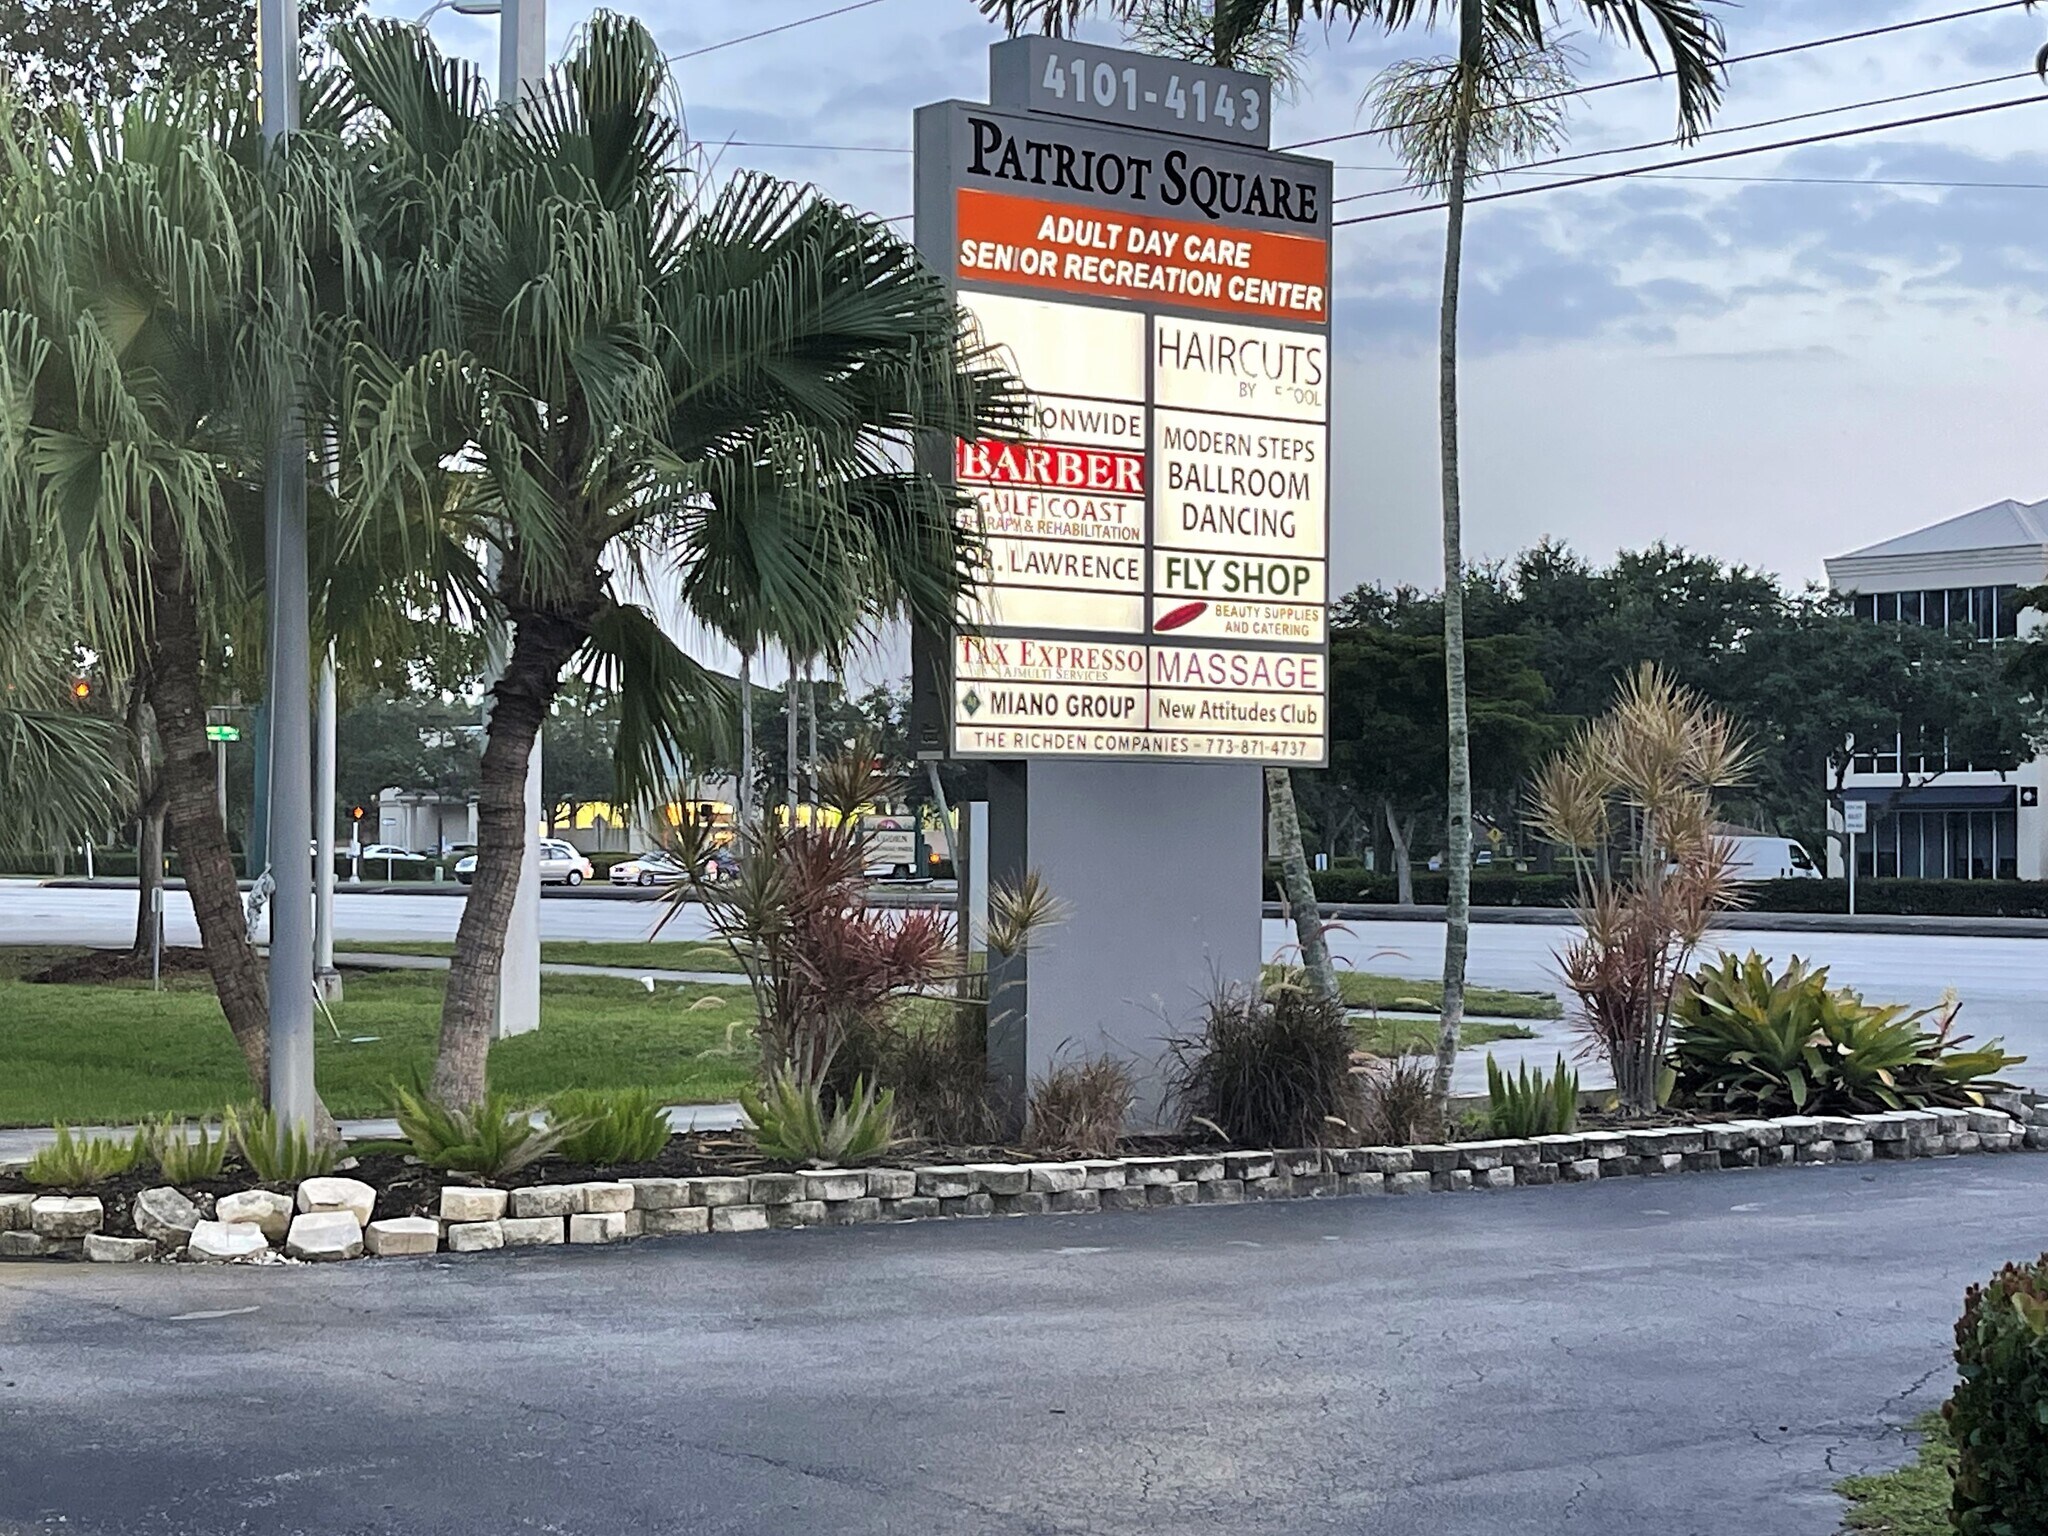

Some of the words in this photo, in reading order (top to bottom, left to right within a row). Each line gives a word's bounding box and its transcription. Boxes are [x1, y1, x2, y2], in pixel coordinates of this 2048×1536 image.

[1042, 54, 1262, 132] 4101-4143
[967, 117, 1152, 200] PATRIOT
[1160, 149, 1319, 224] SQUARE
[1037, 214, 1124, 251] ADULT
[1126, 226, 1179, 257] DAY
[1183, 235, 1252, 268] CARE
[960, 240, 1057, 277] SENIOR
[1064, 254, 1221, 299] RECREATION
[1227, 275, 1323, 311] CENTER
[1158, 326, 1322, 386] HAIRCUTS
[1239, 381, 1257, 398] BY
[1163, 426, 1252, 457] MODERN
[1257, 435, 1315, 463] STEPS
[961, 443, 1144, 492] BARBER
[1168, 461, 1310, 501] BALLROOM
[1047, 497, 1127, 524] COAST
[1182, 502, 1296, 538] DANCING
[1024, 519, 1034, 533] &
[1037, 520, 1141, 541] REHABILITATION
[1010, 549, 1140, 581] LAWRENCE
[1166, 556, 1216, 591] FLY
[1222, 560, 1310, 596] SHOP
[1215, 604, 1261, 619] BEAUTY
[1264, 607, 1319, 622] SUPPLIES
[1225, 621, 1249, 634] AND
[1252, 622, 1309, 636] CATERING
[1020, 640, 1144, 673] EXPRESSO
[1156, 650, 1318, 689] MASSAGE
[1056, 668, 1108, 681] SERVICES
[991, 690, 1059, 716] MIANO
[1066, 694, 1135, 719] GROUP
[1158, 698, 1196, 719] New
[1200, 700, 1276, 722] Attitudes
[1280, 703, 1317, 724] Club
[974, 731, 1005, 748] THE
[1013, 732, 1087, 750] RICHDEN
[1094, 735, 1189, 753] COMPANIES
[1206, 738, 1307, 756] 773-871-4737
